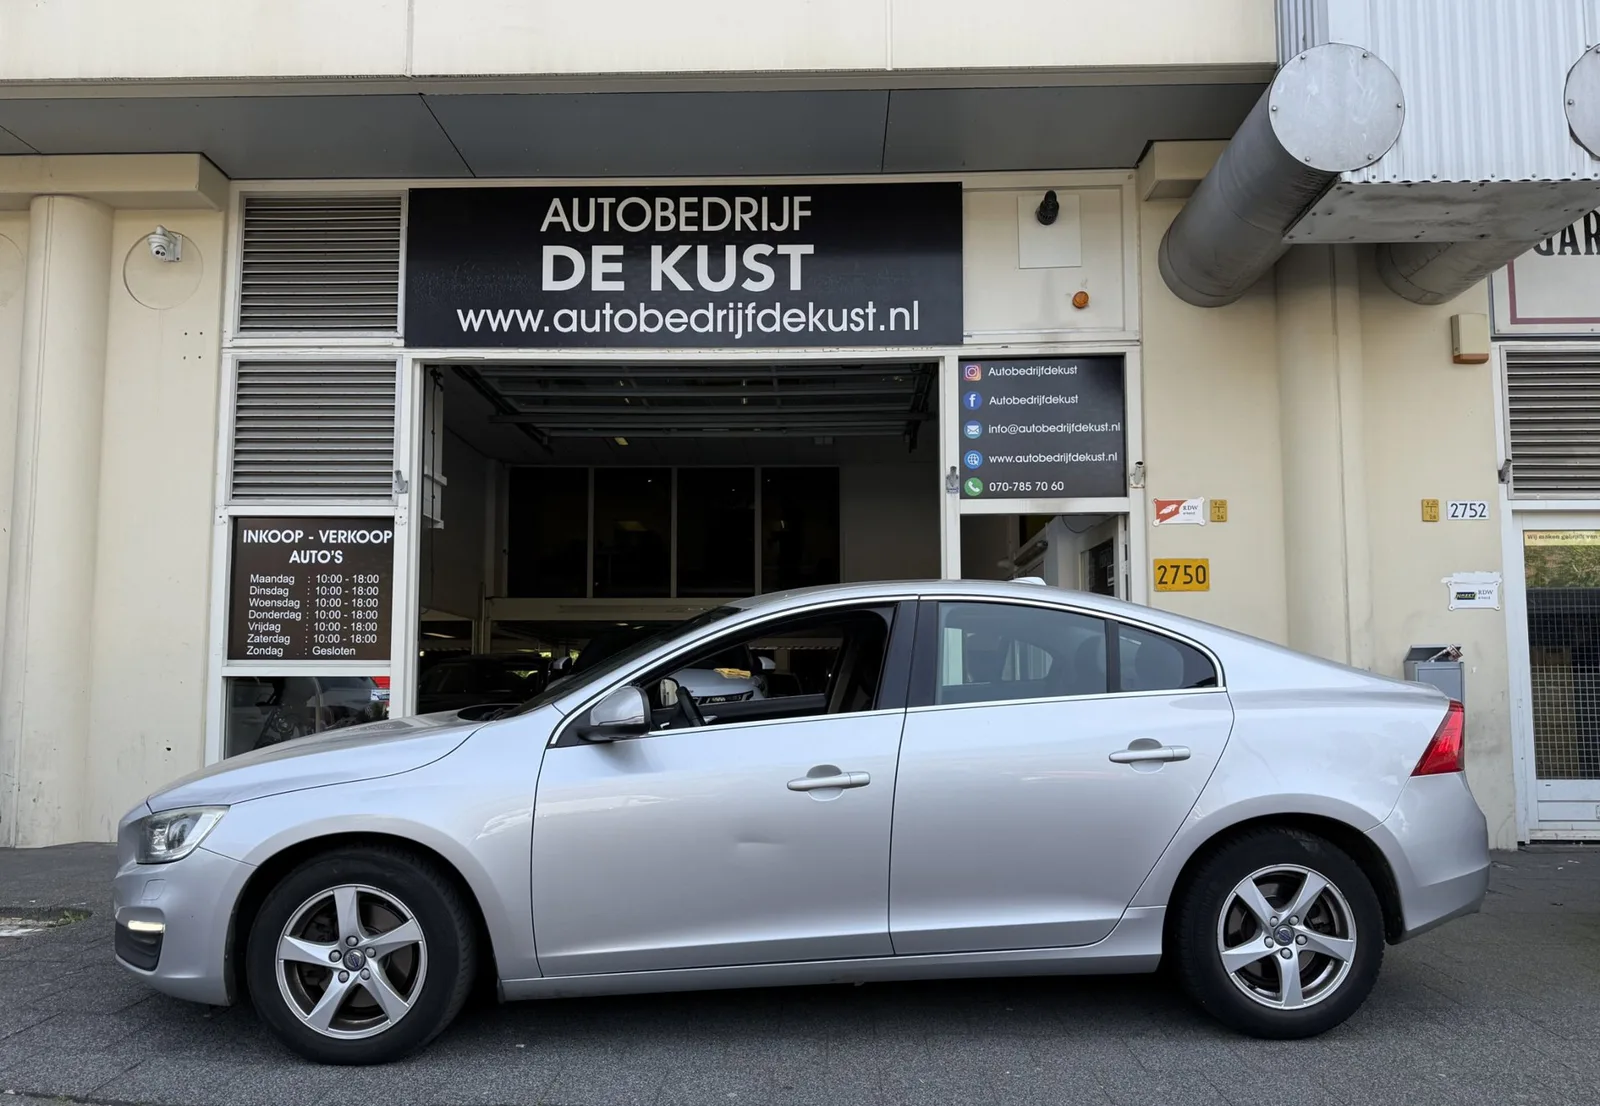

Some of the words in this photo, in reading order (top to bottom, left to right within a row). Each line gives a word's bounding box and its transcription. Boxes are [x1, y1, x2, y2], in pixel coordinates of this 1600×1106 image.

[539, 196, 812, 232] AUTOBEDRIJF
[541, 246, 625, 291] DE
[650, 244, 815, 292] KUST
[456, 301, 919, 339] www.autobedrijfdekust.nl
[988, 366, 1078, 376] Autobedrijfdekust
[988, 395, 1079, 405] Autobedrijfdekust
[988, 423, 1121, 434] info@autobedrijfdekust.nl
[988, 453, 1118, 463] www.autobedrijfdekust.nl
[989, 482, 1032, 491] 070-785
[1035, 482, 1048, 490] 70
[1050, 482, 1065, 490] 60
[1451, 503, 1486, 517] 2752
[243, 530, 304, 543] INKOOP
[318, 530, 393, 543] VERKOOP
[288, 550, 343, 563] AUTO'S
[250, 574, 295, 584] Maandag
[316, 574, 343, 583] 10:00
[352, 575, 380, 583] 18:00
[1158, 565, 1206, 584] 2750
[249, 586, 289, 596] Dinsdag
[315, 586, 343, 595] 10:00
[352, 586, 379, 595] 18:00
[248, 598, 301, 608] Woensdag
[315, 598, 342, 607] 10:00
[351, 598, 379, 607] 18:00
[248, 610, 302, 620] Donderdag
[314, 610, 342, 619] 10:00
[351, 610, 379, 619] 18:00
[247, 622, 281, 632] Vrijdag
[313, 622, 341, 631] 10:00
[350, 622, 378, 631] 18:00
[246, 634, 291, 644] Zaterdag
[313, 634, 341, 643] 10:00
[350, 634, 378, 643] 18:00
[246, 646, 284, 656] Zondag
[312, 646, 356, 655] Gesloten
